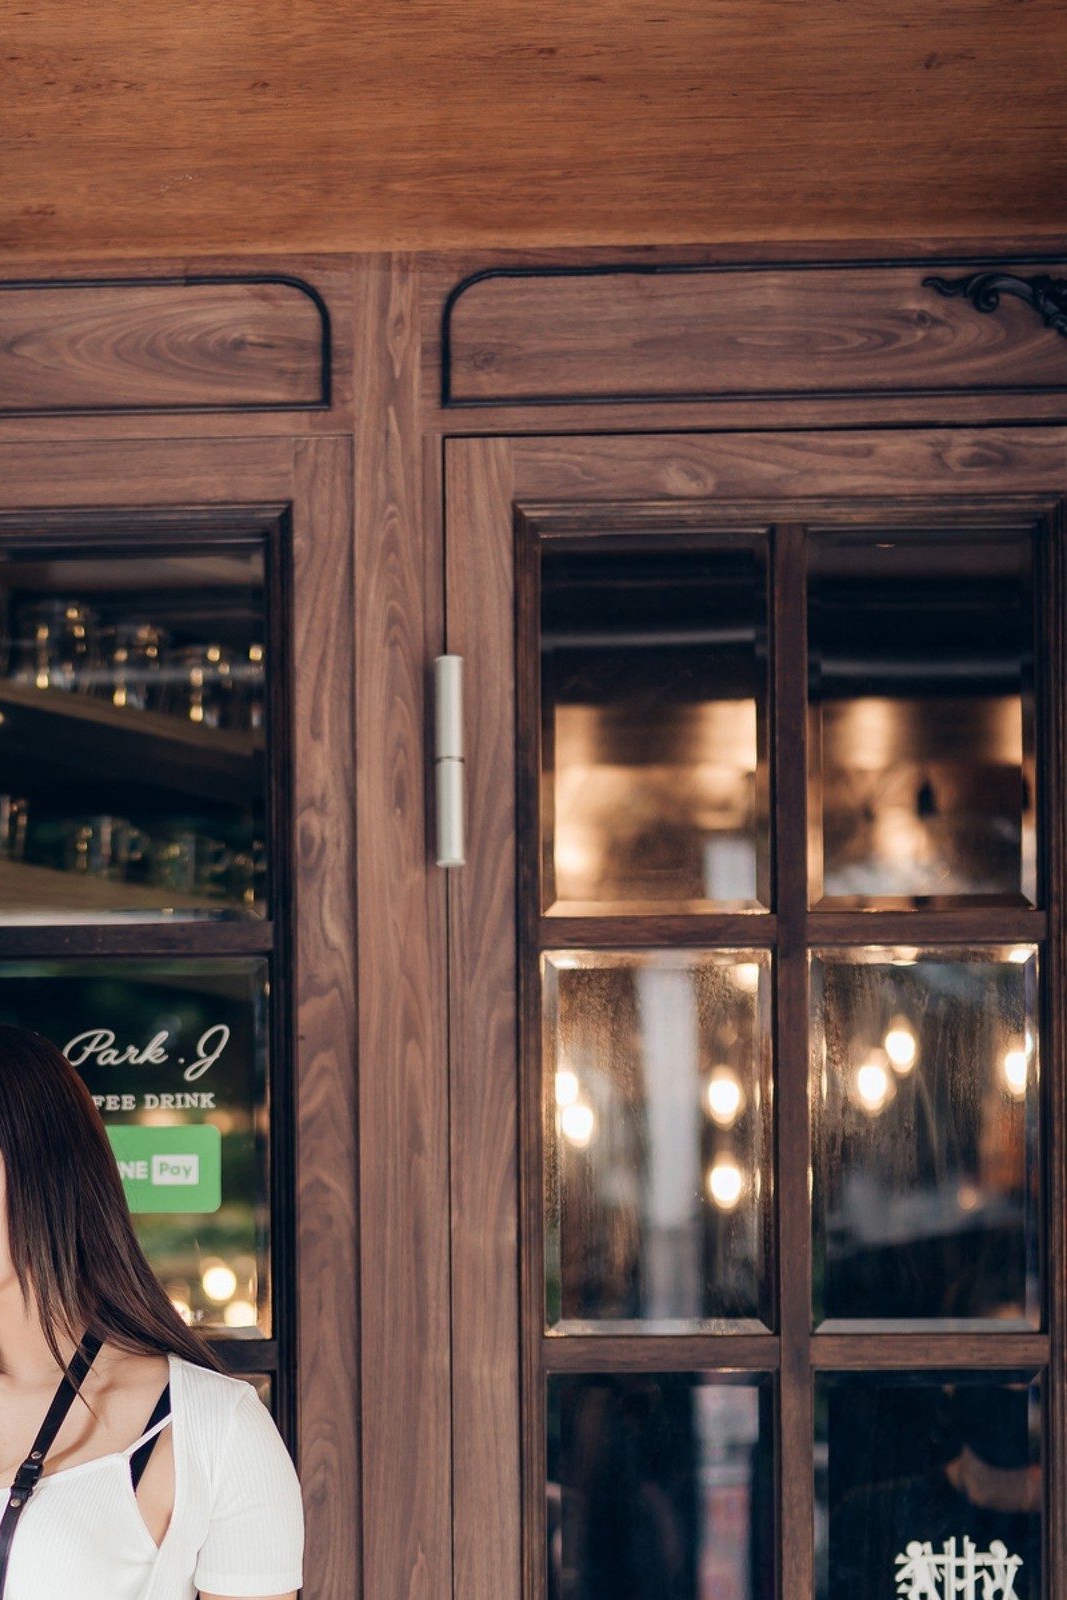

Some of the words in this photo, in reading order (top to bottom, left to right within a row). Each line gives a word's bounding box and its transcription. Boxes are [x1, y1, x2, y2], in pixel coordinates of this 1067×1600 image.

[62, 1028, 169, 1067] Park
[91, 1093, 137, 1111] FEE
[143, 1092, 217, 1110] DRINK
[117, 1160, 149, 1180] NE
[158, 1161, 193, 1180] Pay
